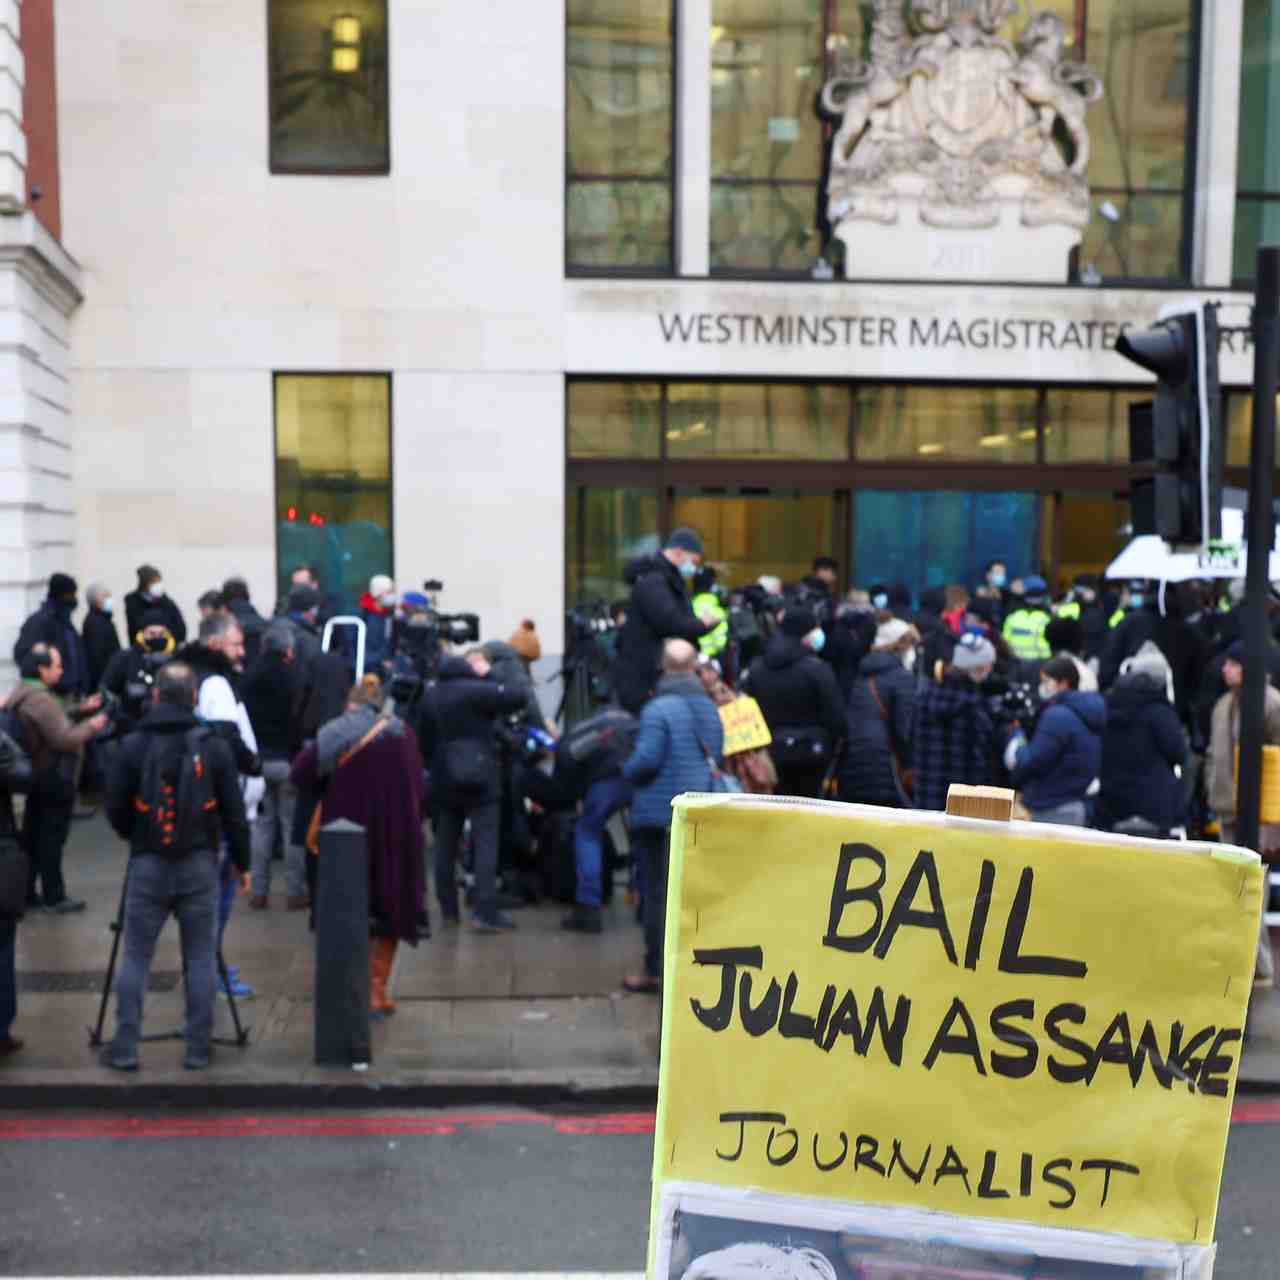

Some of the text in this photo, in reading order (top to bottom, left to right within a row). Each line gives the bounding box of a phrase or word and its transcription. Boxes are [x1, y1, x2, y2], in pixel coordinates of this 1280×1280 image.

[658, 313, 898, 347] WESTMINSTER
[822, 842, 1088, 979] BAIL
[689, 945, 1242, 1098] JULIAN ASSANGE
[715, 1112, 1140, 1209] JOURNALIST
